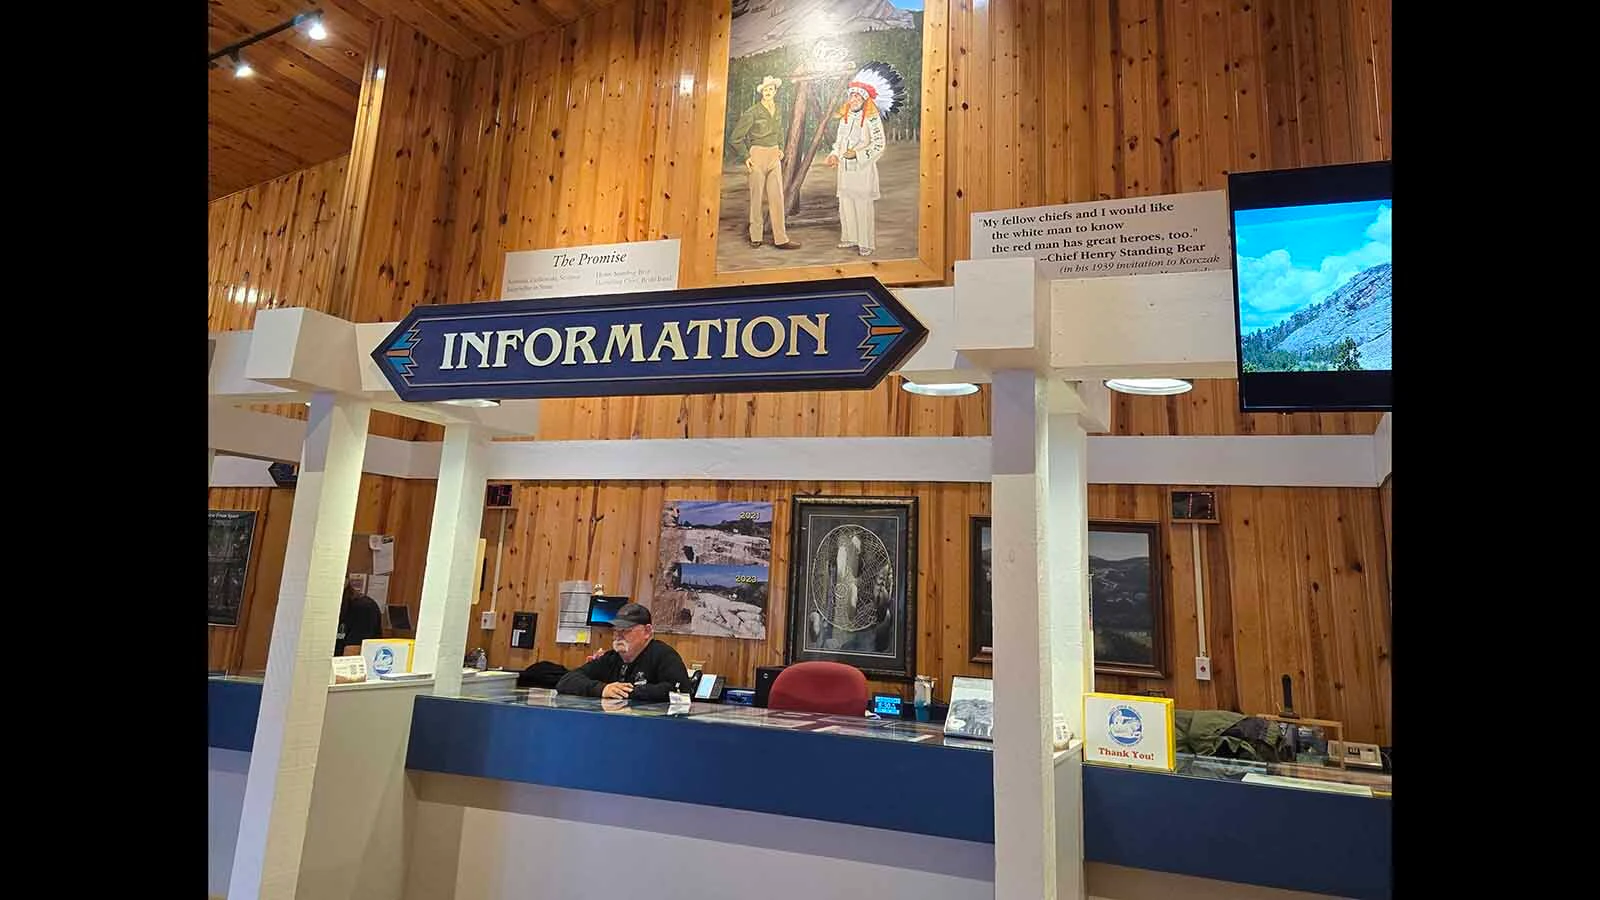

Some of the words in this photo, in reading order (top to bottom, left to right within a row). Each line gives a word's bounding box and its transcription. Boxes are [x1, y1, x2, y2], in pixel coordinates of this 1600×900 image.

[979, 218, 999, 228] "My
[1002, 215, 1036, 225] fellow
[1039, 211, 1073, 222] chiefs
[1076, 209, 1097, 218] and
[1101, 208, 1106, 216] I
[1109, 204, 1146, 216] would
[1150, 203, 1174, 212] like
[992, 231, 1010, 240] the
[1012, 229, 1044, 238] white
[1047, 226, 1072, 235] man
[1076, 225, 1088, 233] to
[1091, 222, 1124, 231] know
[992, 244, 1010, 253] the
[1013, 242, 1031, 252] red
[1034, 241, 1060, 250] man
[1063, 239, 1083, 248] has
[1086, 237, 1116, 248] great
[1169, 227, 1198, 239] too."
[552, 254, 575, 267] The
[578, 251, 627, 266] Promise
[1081, 250, 1117, 261] Henry
[1120, 245, 1174, 257] Standing
[1177, 243, 1206, 253] Bear
[1075, 263, 1089, 272] his
[1092, 261, 1114, 271] 1939
[1116, 258, 1164, 270] invitation
[1166, 258, 1177, 266] to
[1179, 255, 1220, 265] Korczak
[439, 313, 831, 370] INFORMATION
[739, 511, 761, 520] 2021
[735, 575, 758, 583] 2023
[1098, 747, 1130, 758] Thank
[1131, 750, 1155, 761] You!
